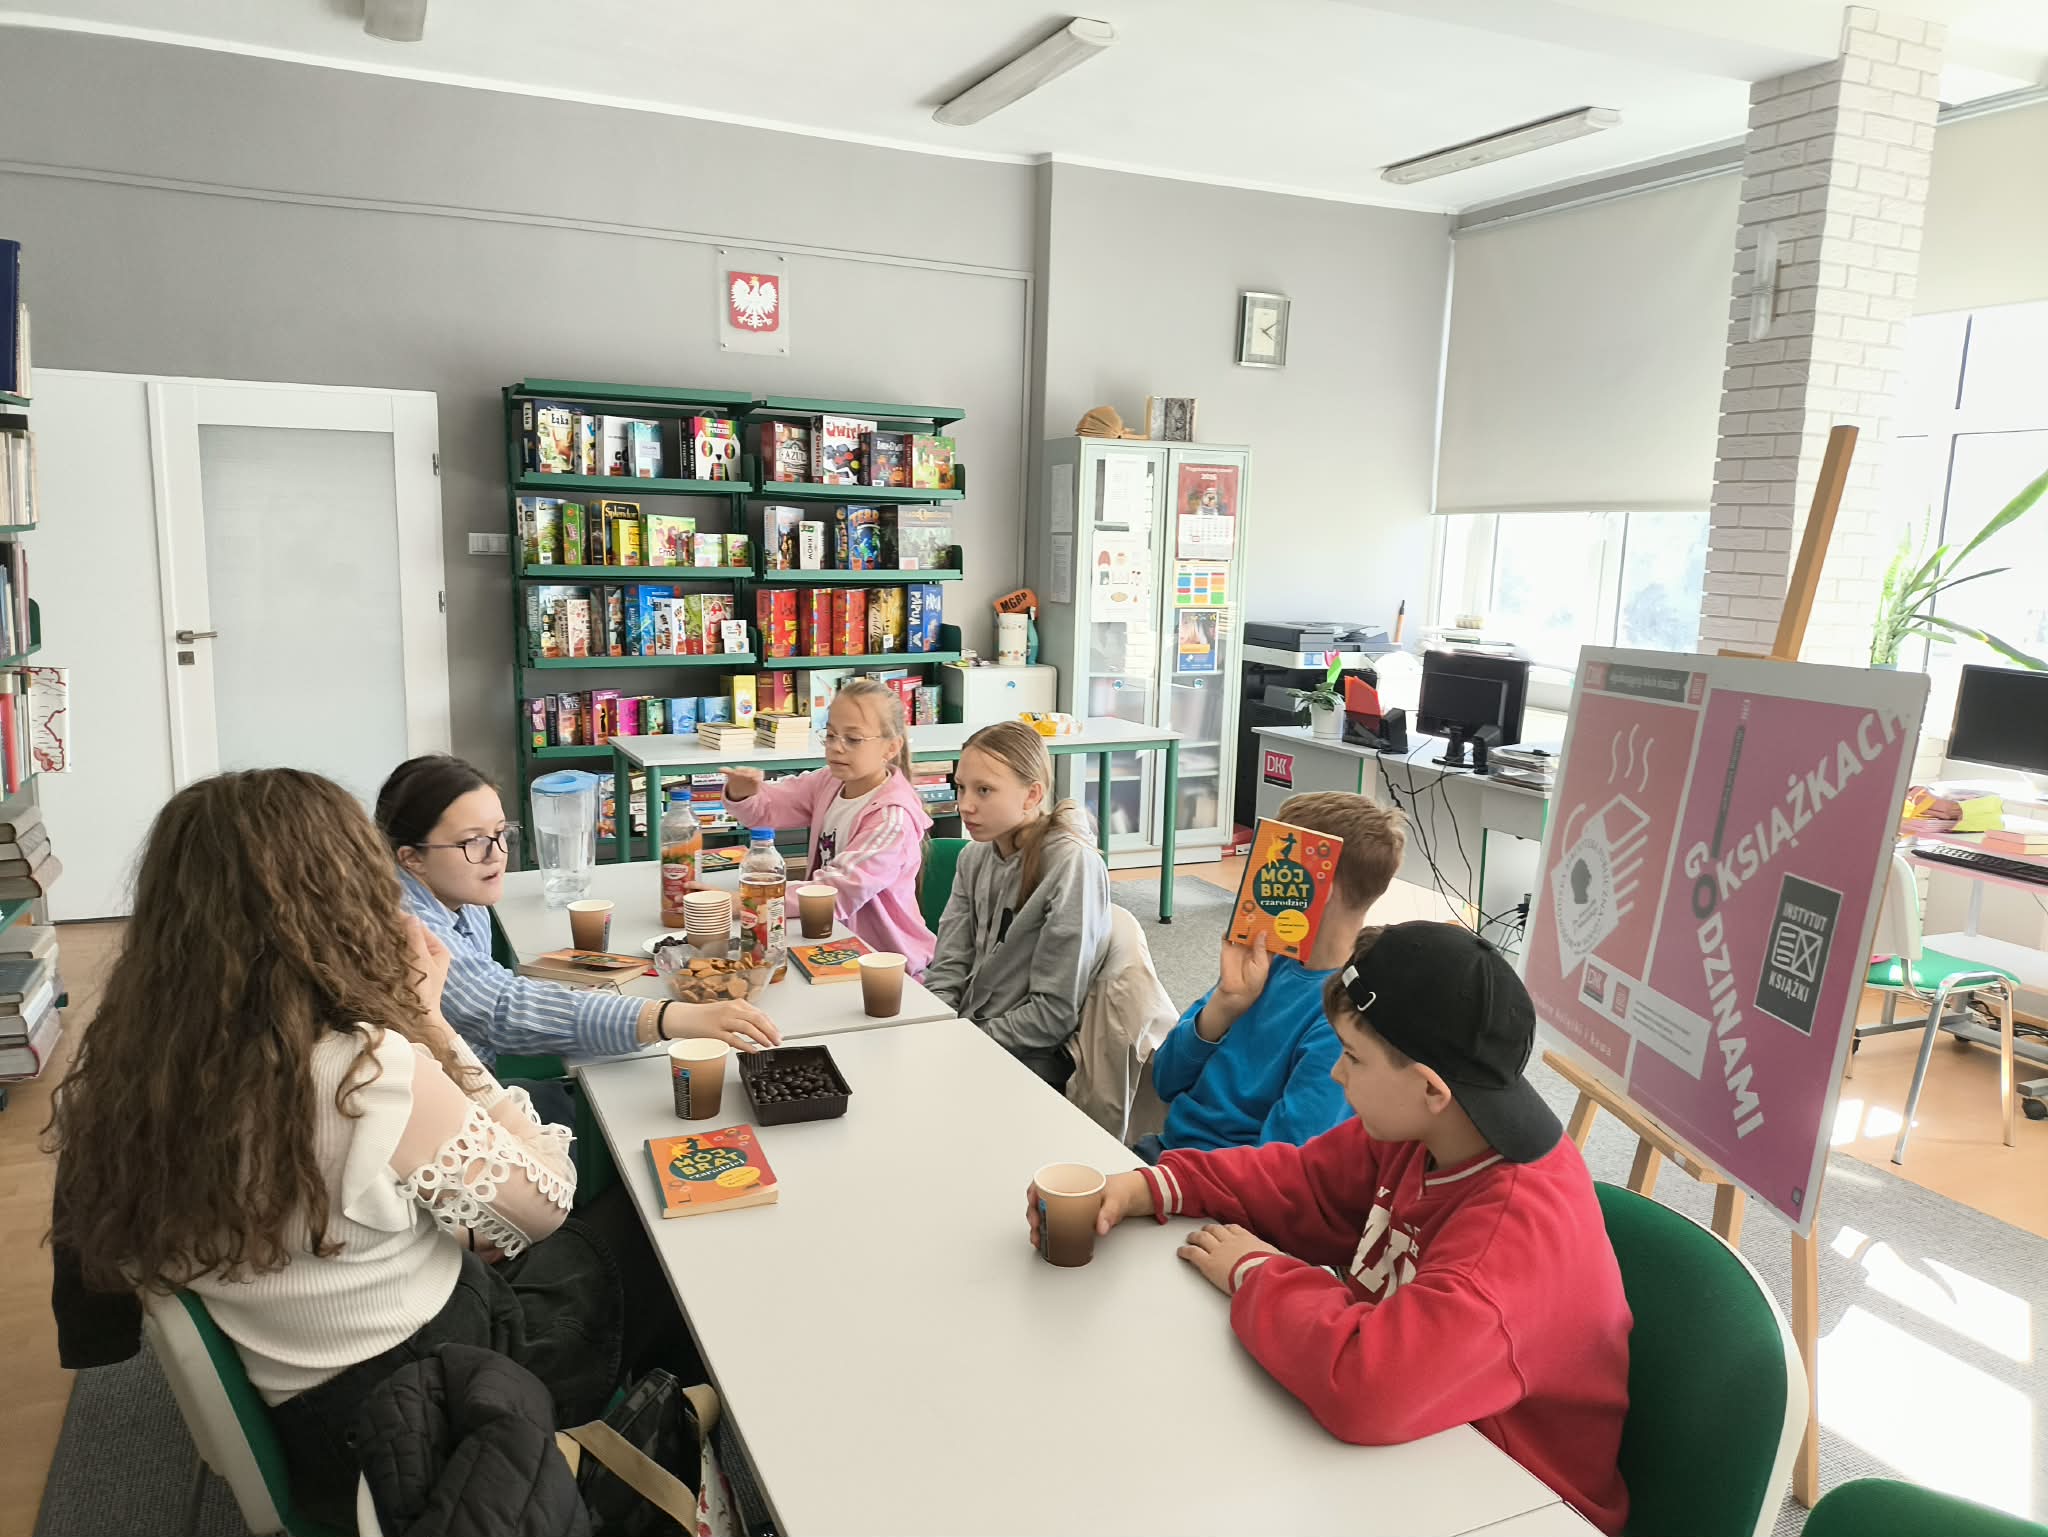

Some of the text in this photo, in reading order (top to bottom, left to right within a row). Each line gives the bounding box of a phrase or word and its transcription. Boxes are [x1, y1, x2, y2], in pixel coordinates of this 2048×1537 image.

[1260, 865, 1304, 883] MÓJ
[1261, 883, 1311, 898] BRAT
[1260, 898, 1308, 908] czarodziej
[1782, 901, 1828, 932] INSTYTUT
[1768, 970, 1809, 1003] KSIĄŻKI
[682, 1152, 739, 1176] BRAT
